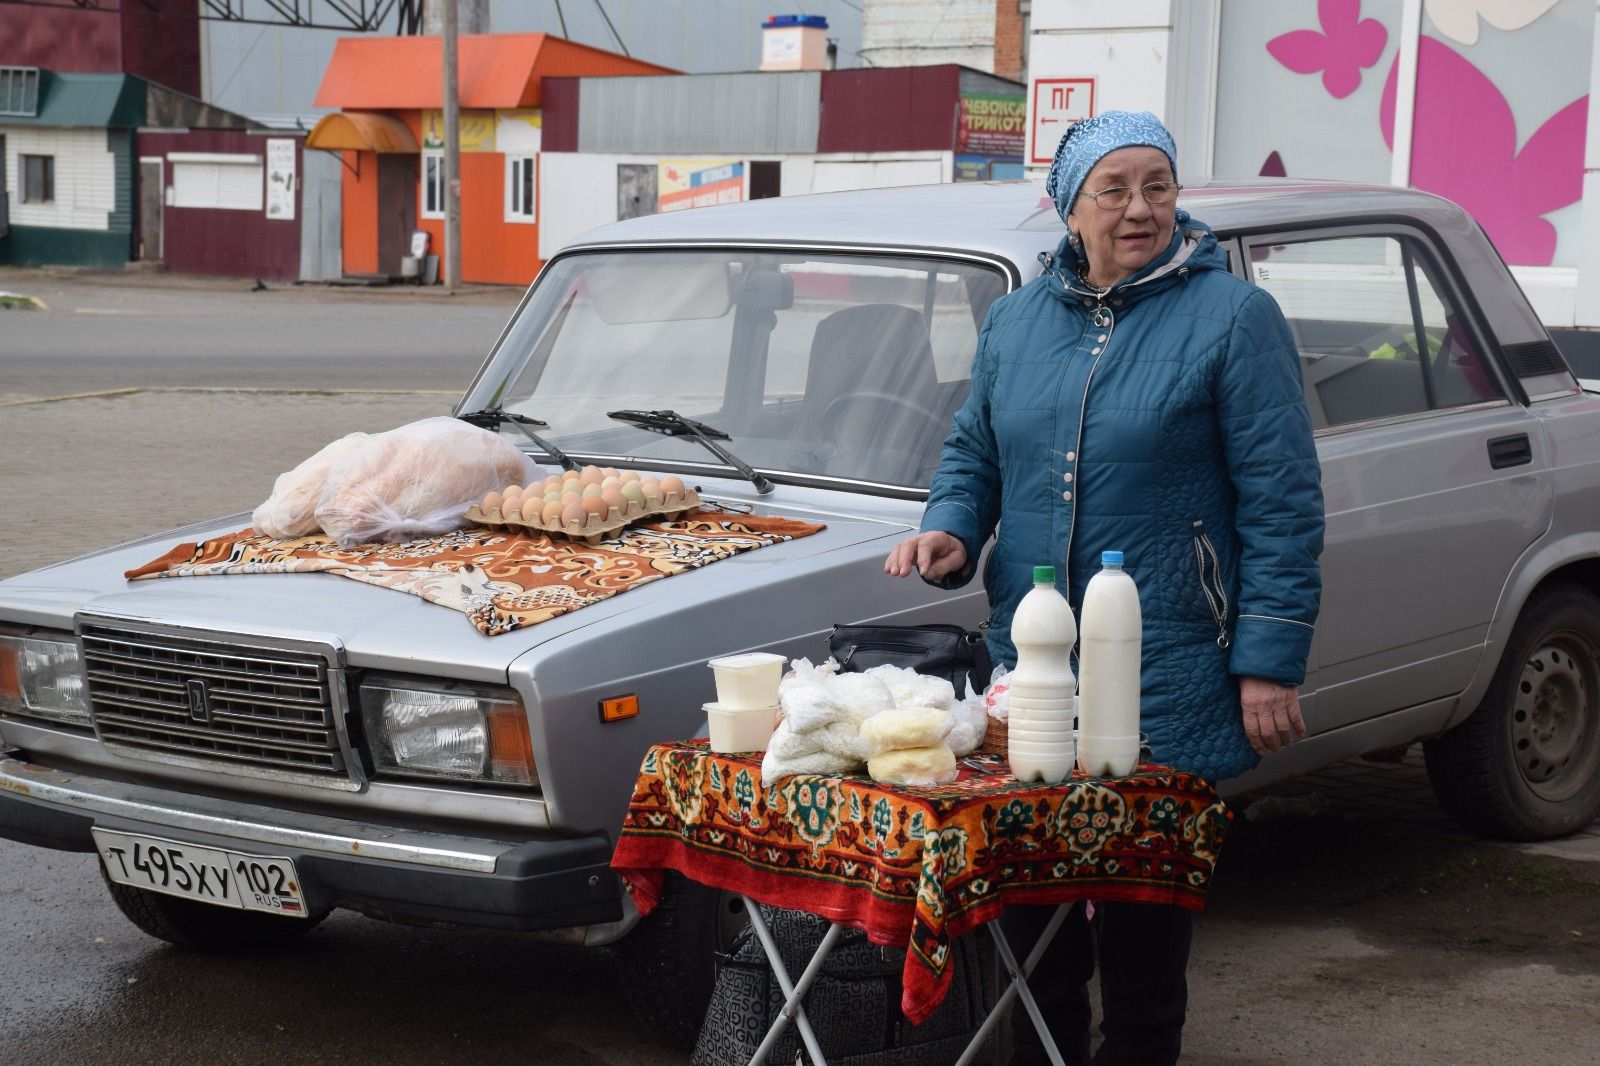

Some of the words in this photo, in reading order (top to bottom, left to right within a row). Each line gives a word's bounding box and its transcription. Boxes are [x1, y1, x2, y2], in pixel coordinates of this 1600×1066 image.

[1052, 87, 1074, 110] ПГ
[966, 115, 1026, 133] ТРИКОТ
[236, 860, 291, 896] 102
[254, 893, 281, 908] RUS
